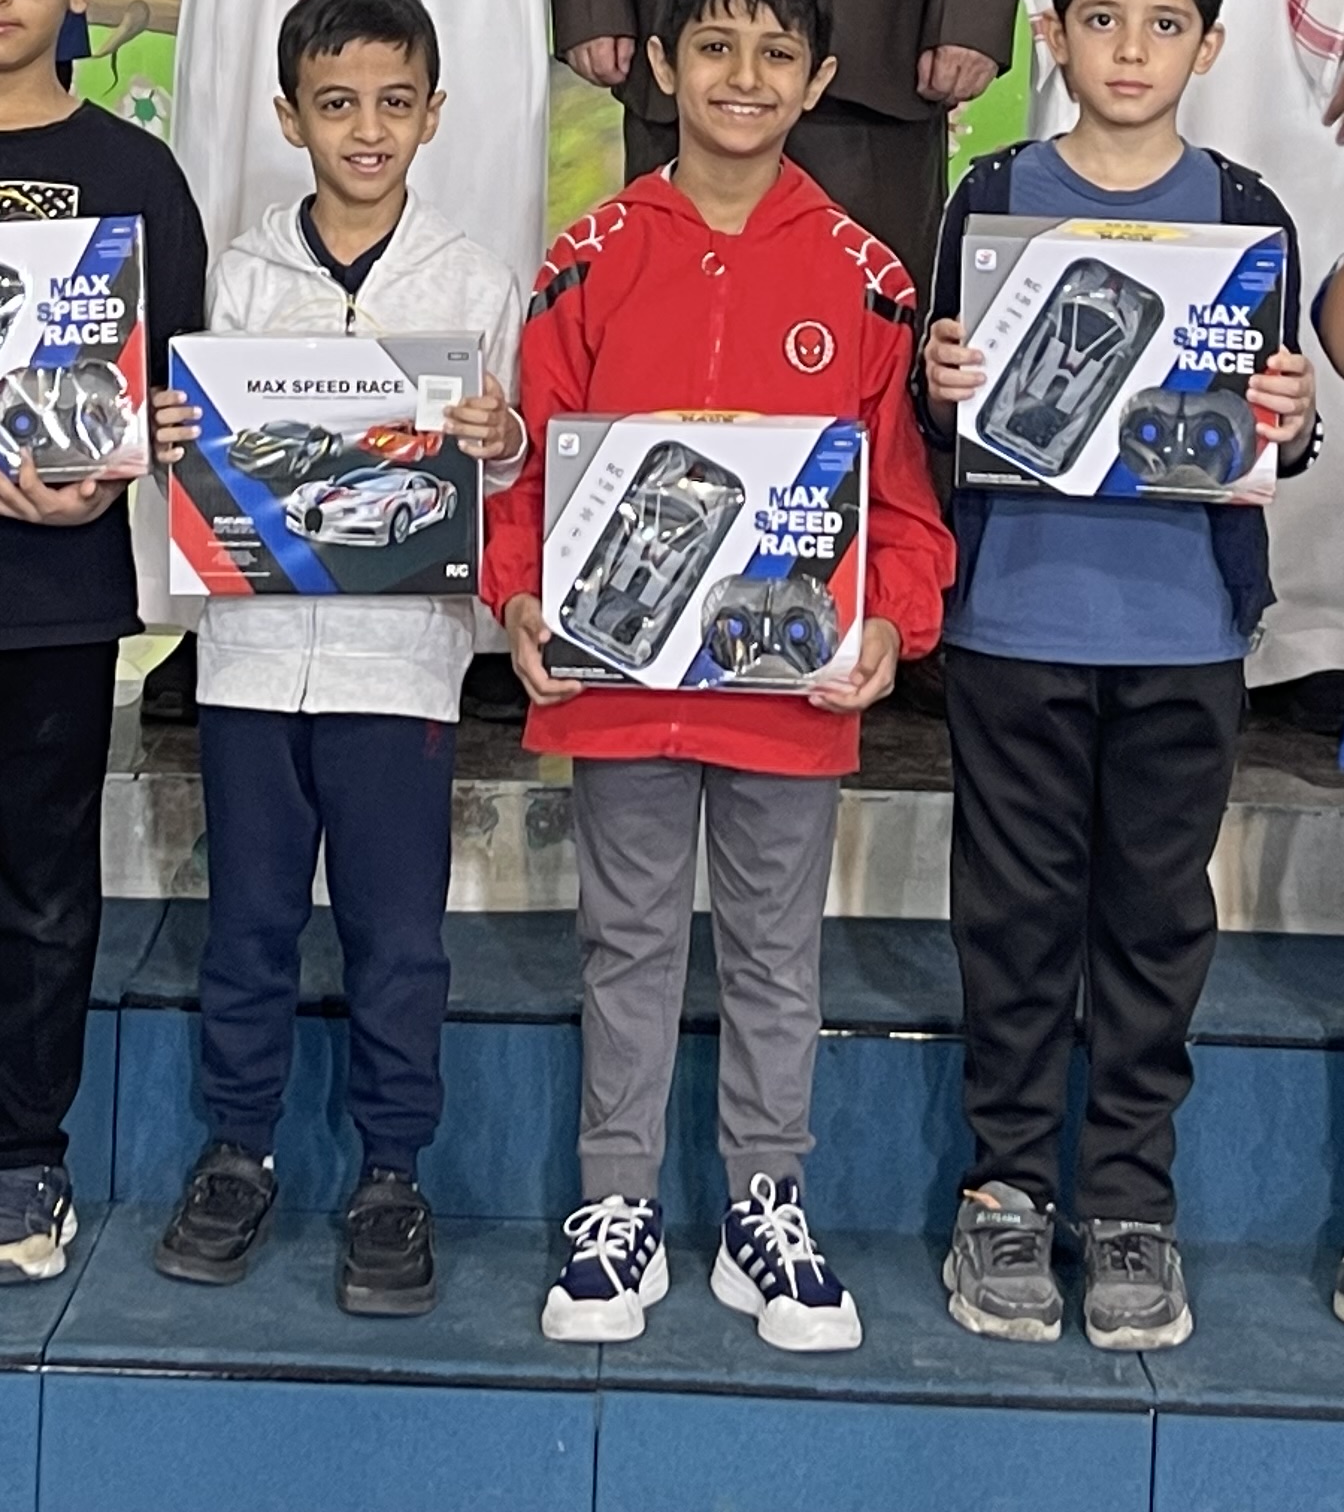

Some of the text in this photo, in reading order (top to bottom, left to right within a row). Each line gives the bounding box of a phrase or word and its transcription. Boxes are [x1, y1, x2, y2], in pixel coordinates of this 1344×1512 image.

[49, 274, 111, 299] MAX
[36, 297, 125, 325] SPEED
[1188, 303, 1250, 327] MAX
[43, 322, 119, 347] RACE
[1173, 326, 1264, 352] SPEED
[1178, 349, 1255, 375] RACE
[247, 379, 405, 394] MAX SPEED RACE
[768, 485, 830, 509] MAX
[754, 509, 843, 535] SPEED
[758, 534, 835, 560] RACE
